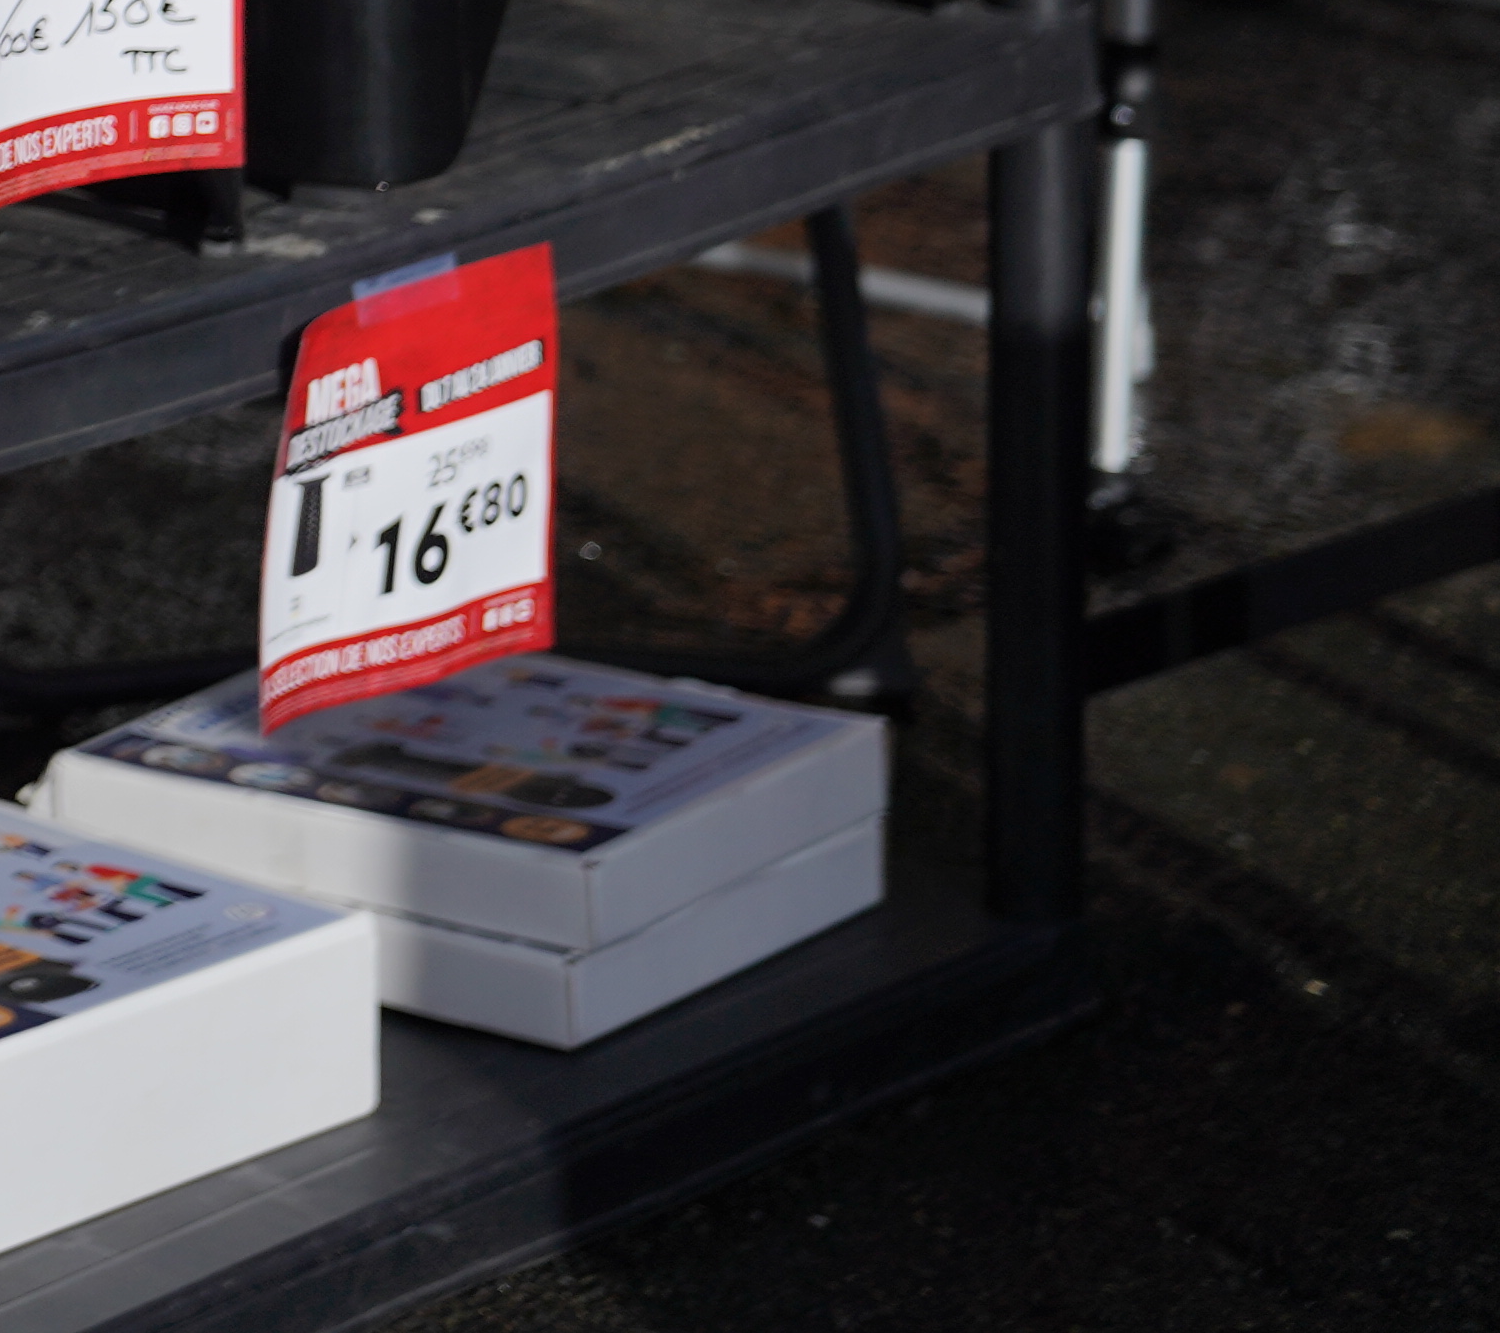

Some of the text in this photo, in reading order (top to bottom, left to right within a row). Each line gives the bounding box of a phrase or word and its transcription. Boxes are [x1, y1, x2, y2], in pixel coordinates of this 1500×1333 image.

[119, 45, 189, 75] TTC
[13, 130, 43, 169] NOS
[41, 113, 119, 160] EXPERTS
[373, 474, 528, 596] 16€80
